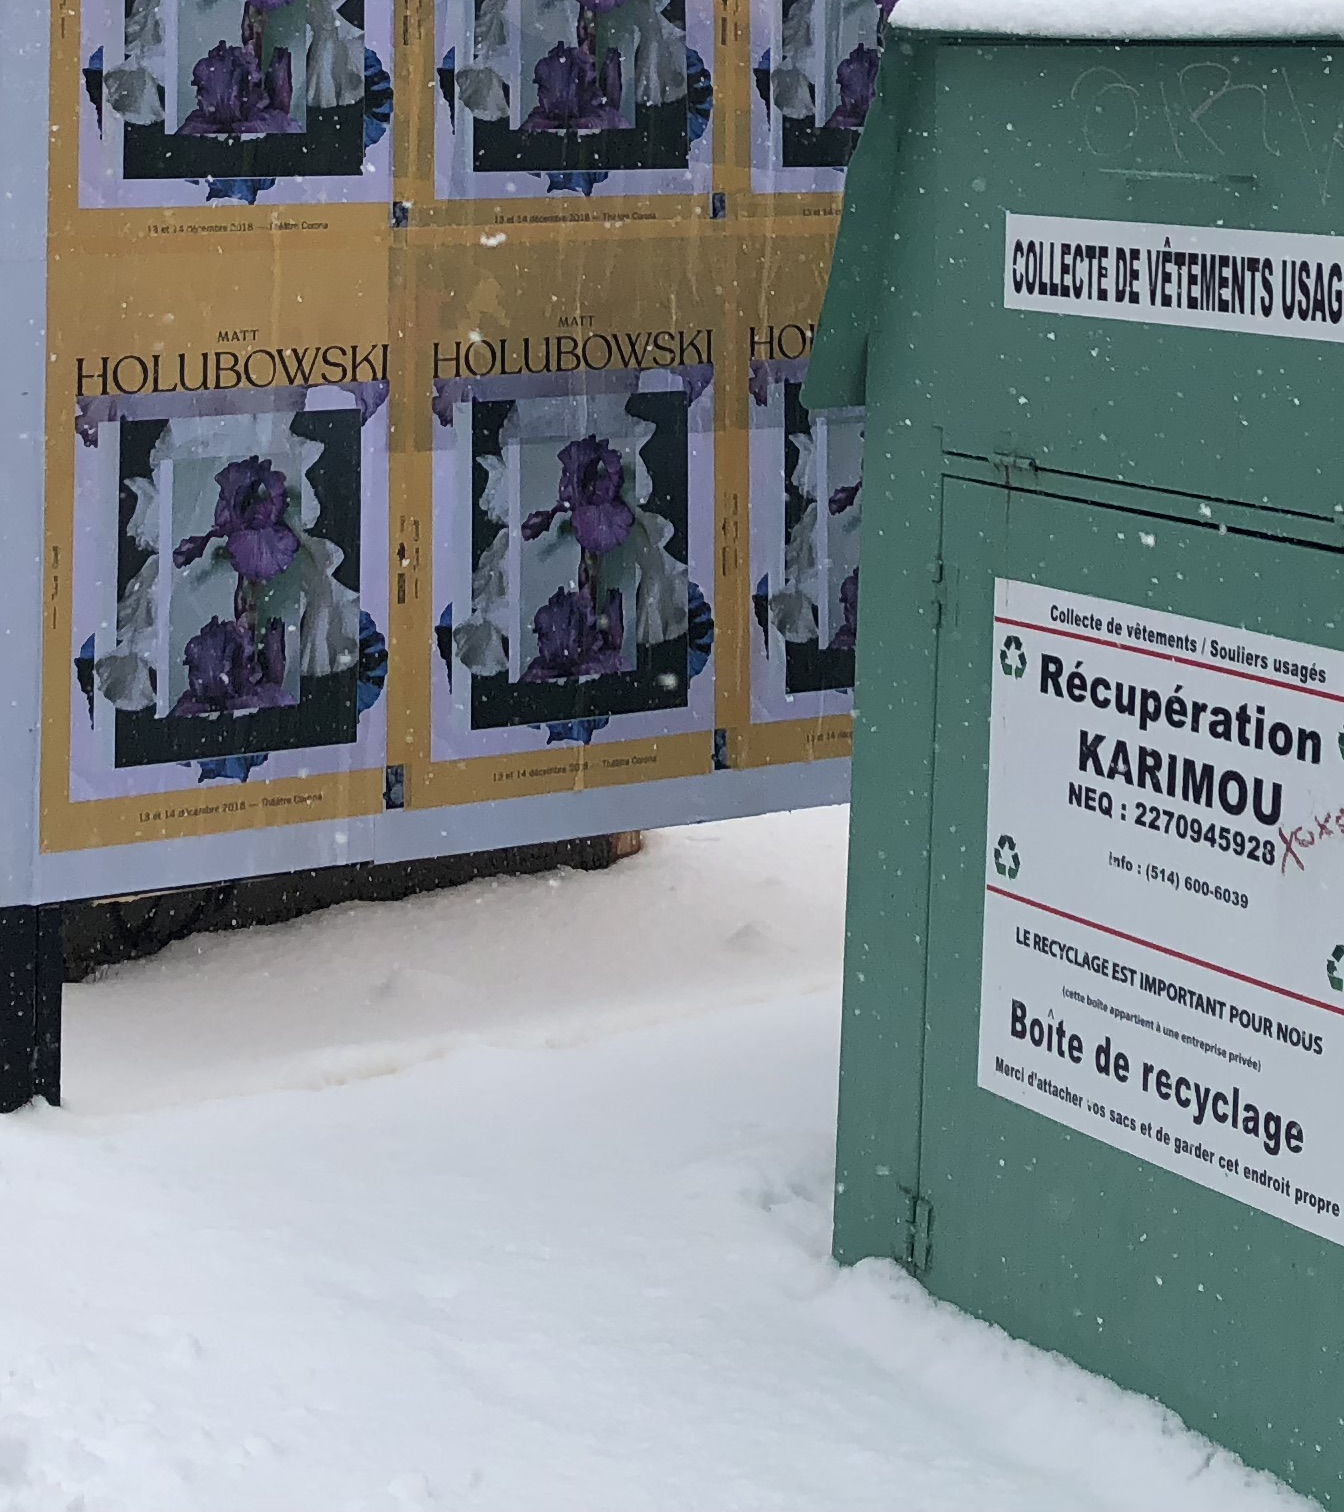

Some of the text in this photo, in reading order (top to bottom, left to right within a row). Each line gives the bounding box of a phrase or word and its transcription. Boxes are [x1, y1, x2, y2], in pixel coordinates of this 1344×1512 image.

[1012, 238, 1109, 303] COLLECTE
[1115, 246, 1141, 305] DE
[1146, 236, 1274, 318] VÊTEMENTS
[217, 329, 259, 343] MATT
[431, 328, 714, 381] HOLUBOWSKI
[558, 314, 595, 330] MATT
[74, 343, 389, 397] HOLUBOWSKI
[1049, 604, 1103, 633] Collecte
[1106, 614, 1123, 637] de
[1126, 622, 1198, 654] vêtements
[1210, 639, 1269, 671] Souliers
[1273, 657, 1327, 686] usagés
[1039, 652, 1322, 766] Récupération
[221, 800, 246, 813] 2018
[1068, 781, 1114, 819] NEQ
[1078, 729, 1283, 827] KARIMOU
[1108, 852, 1133, 872] Info
[1145, 863, 1180, 891] (514)
[1184, 876, 1249, 909] 600-6039
[1015, 926, 1324, 1056] LE RECYCLAGE EST IMPORTANT POUR NOUS
[1062, 985, 1085, 1004] (cette
[1109, 1006, 1154, 1031] appartient
[1163, 1025, 1180, 1041] une
[1181, 1033, 1227, 1059] entreprise
[1228, 1051, 1262, 1073] privée)
[1010, 998, 1305, 1156] Boîte de recyclage
[995, 1055, 1025, 1083] Merci
[1027, 1071, 1084, 1108] d'attacher
[1109, 1109, 1137, 1132] sacs
[1140, 1122, 1153, 1138] et
[1156, 1126, 1171, 1146] de
[1173, 1135, 1216, 1165] garder
[1218, 1153, 1240, 1176] cet
[1243, 1162, 1291, 1198] endroit
[1294, 1184, 1341, 1219] propre
